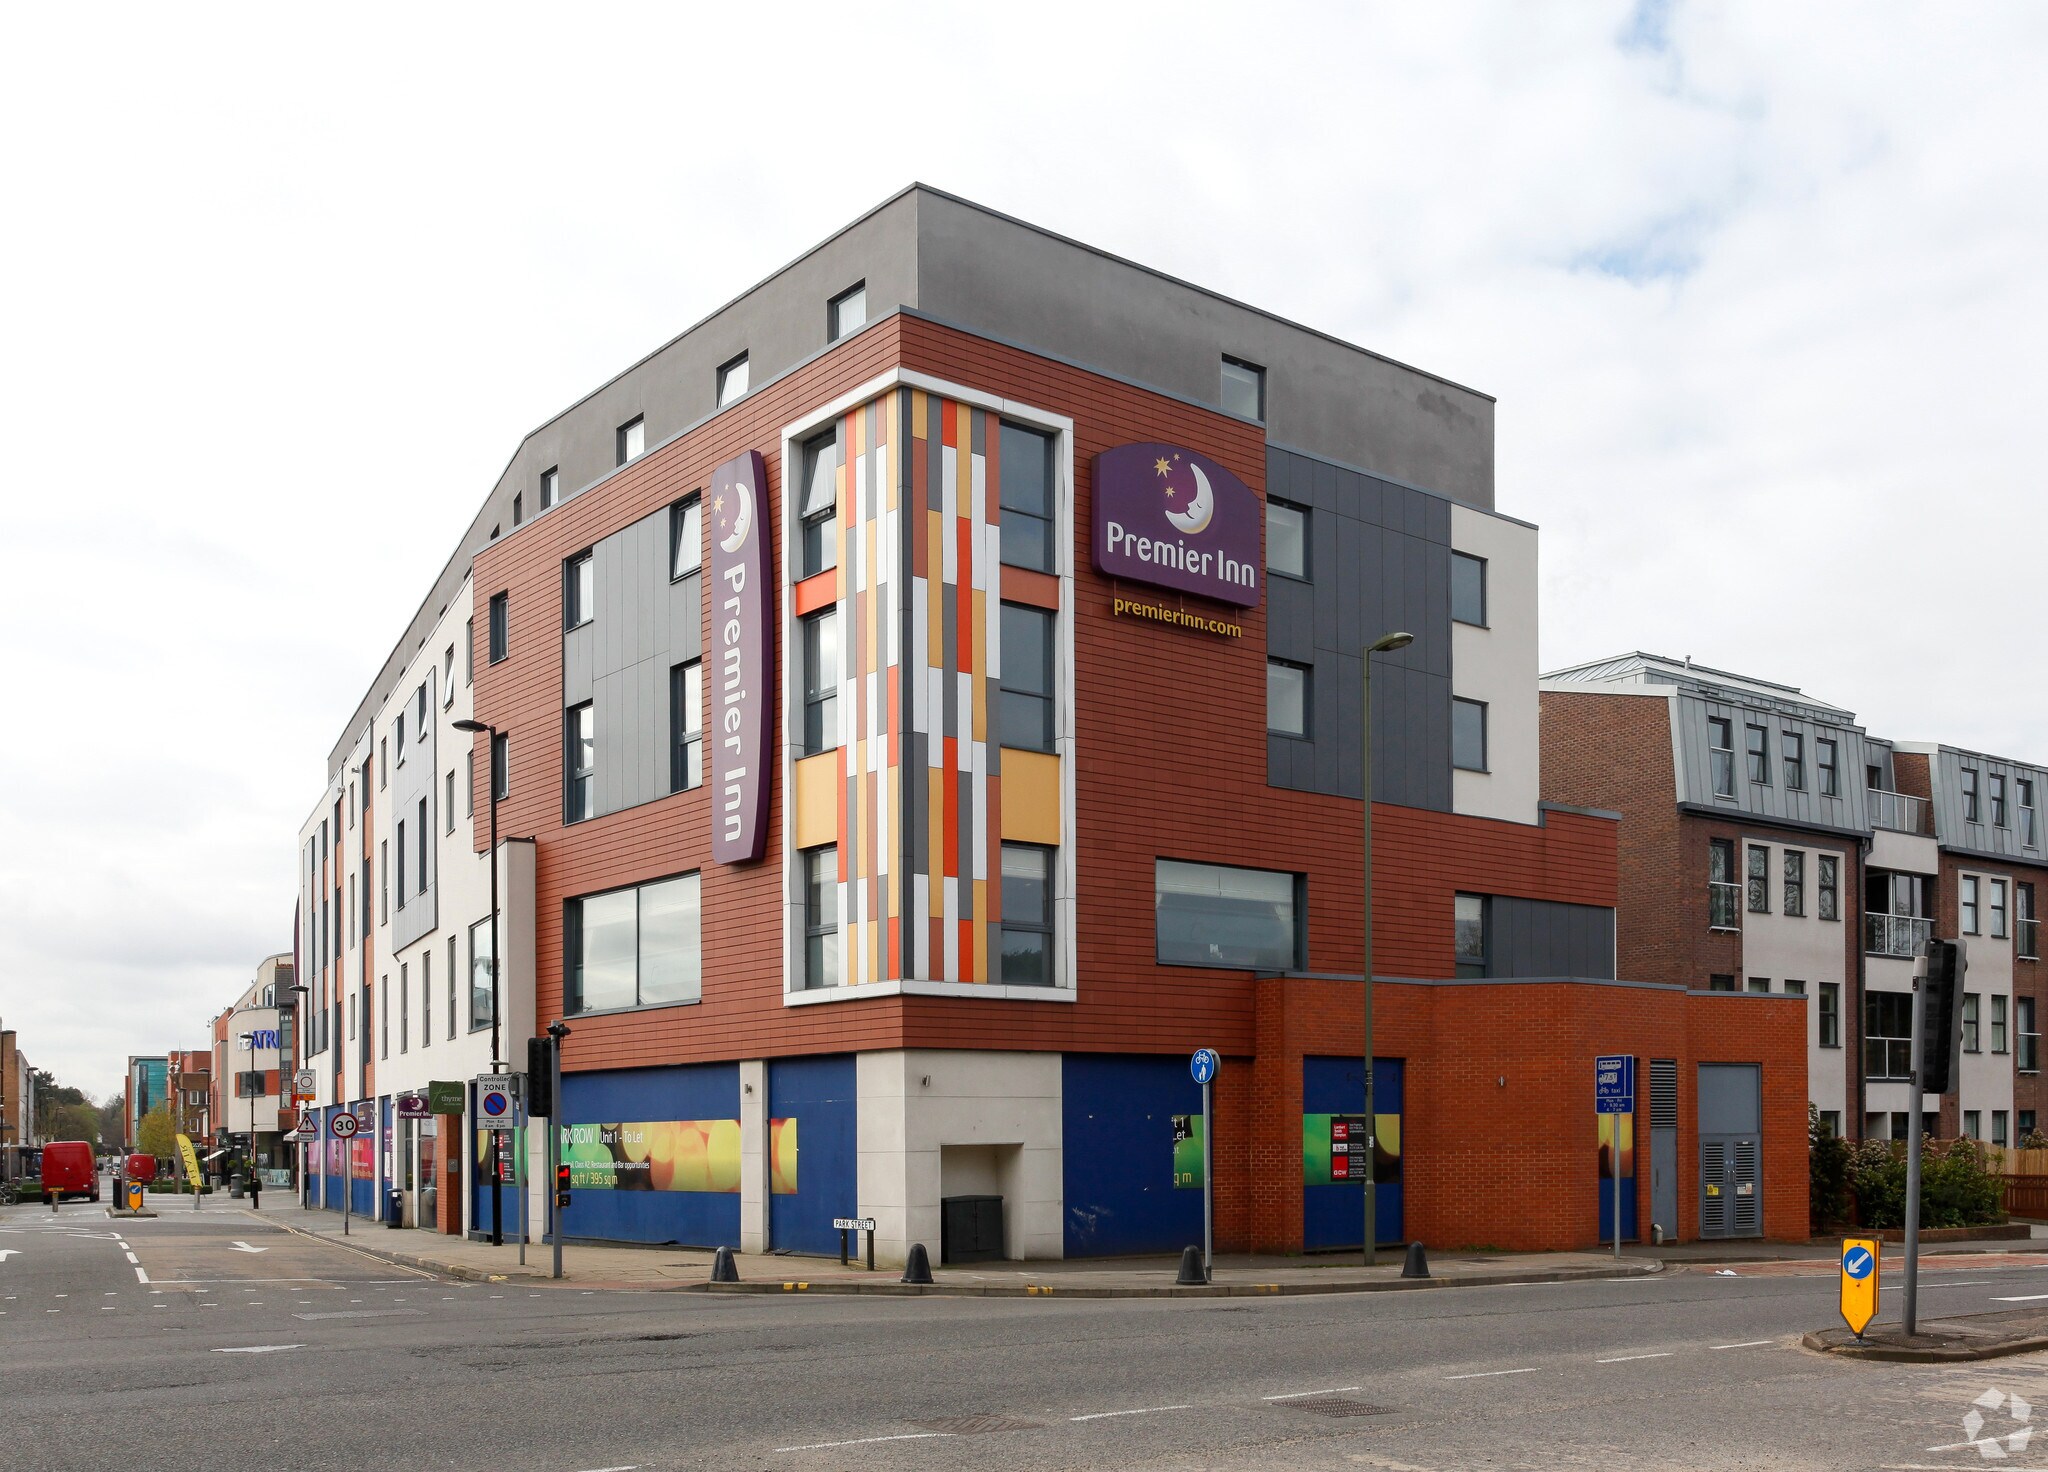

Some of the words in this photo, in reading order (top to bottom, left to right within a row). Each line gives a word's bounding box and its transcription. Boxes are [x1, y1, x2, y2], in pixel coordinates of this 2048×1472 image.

[1107, 521, 1213, 576] Premier
[1218, 550, 1255, 588] Inn
[1113, 597, 1242, 638] premierinn.com
[723, 562, 746, 756] Premier
[724, 766, 746, 842] Inn
[441, 1094, 463, 1103] thyme
[335, 1120, 355, 1132] 30
[574, 1127, 594, 1144] ROW
[600, 1131, 613, 1144] Unit
[614, 1131, 618, 1144] 1
[624, 1131, 632, 1143] To
[633, 1131, 643, 1143] Let
[625, 1161, 650, 1170] opportunities
[571, 1174, 579, 1187] sq
[579, 1172, 586, 1184] ft
[590, 1172, 603, 1185] 395
[1182, 1172, 1192, 1183] m
[835, 1220, 850, 1228] PARK
[850, 1220, 872, 1229] STREET
